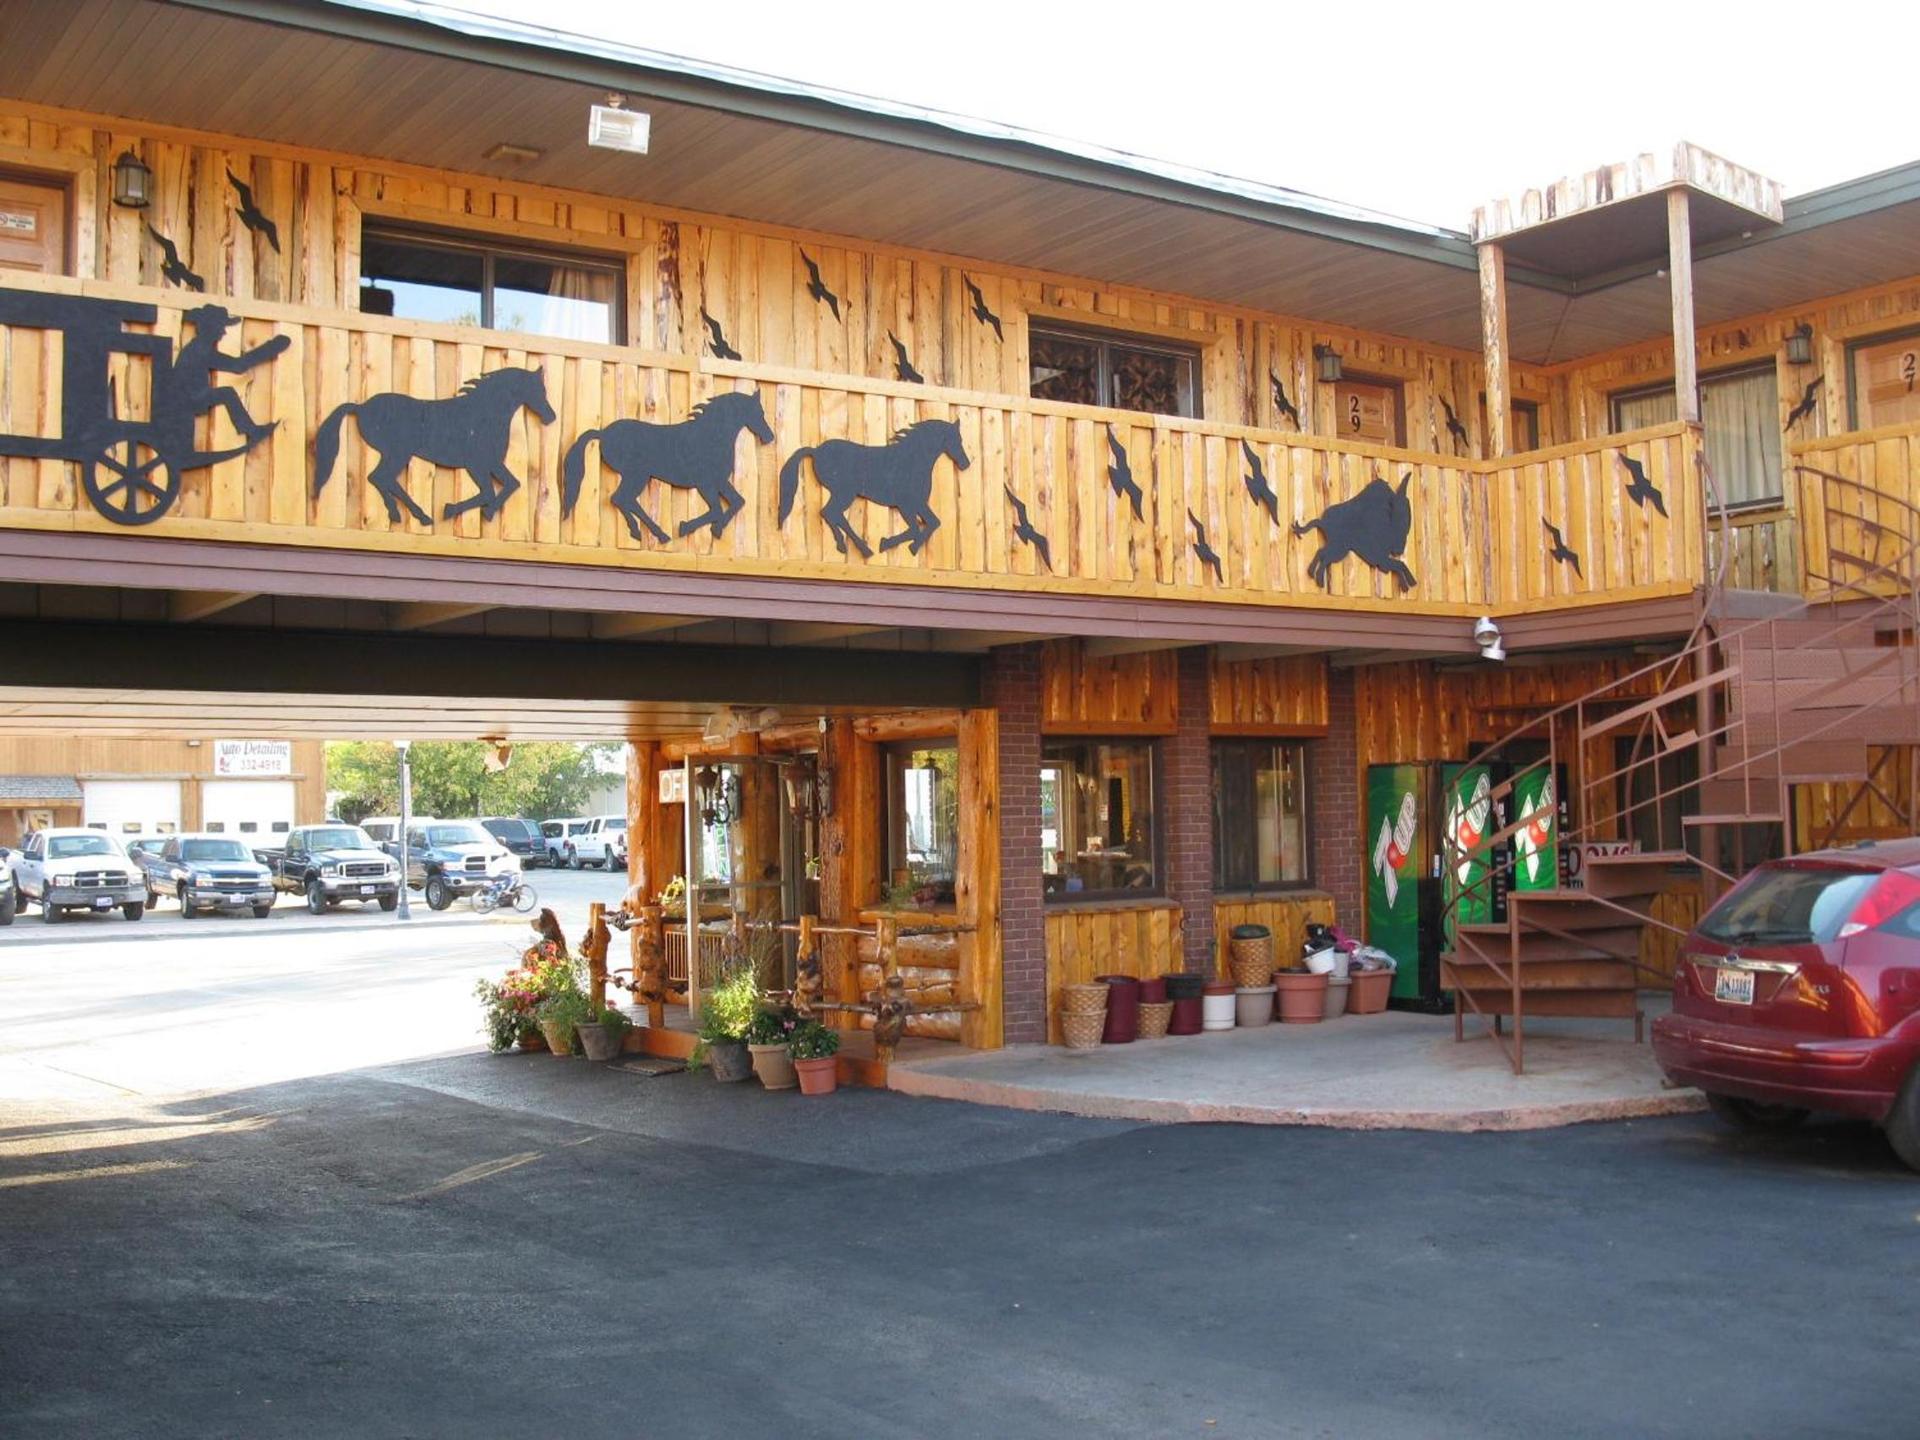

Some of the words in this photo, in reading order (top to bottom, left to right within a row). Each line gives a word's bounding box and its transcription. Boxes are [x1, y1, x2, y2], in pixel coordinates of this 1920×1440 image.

[1903, 353, 1916, 392] 27
[1350, 395, 1361, 433] 29
[218, 742, 242, 755] Auto
[243, 741, 289, 757] Detailing
